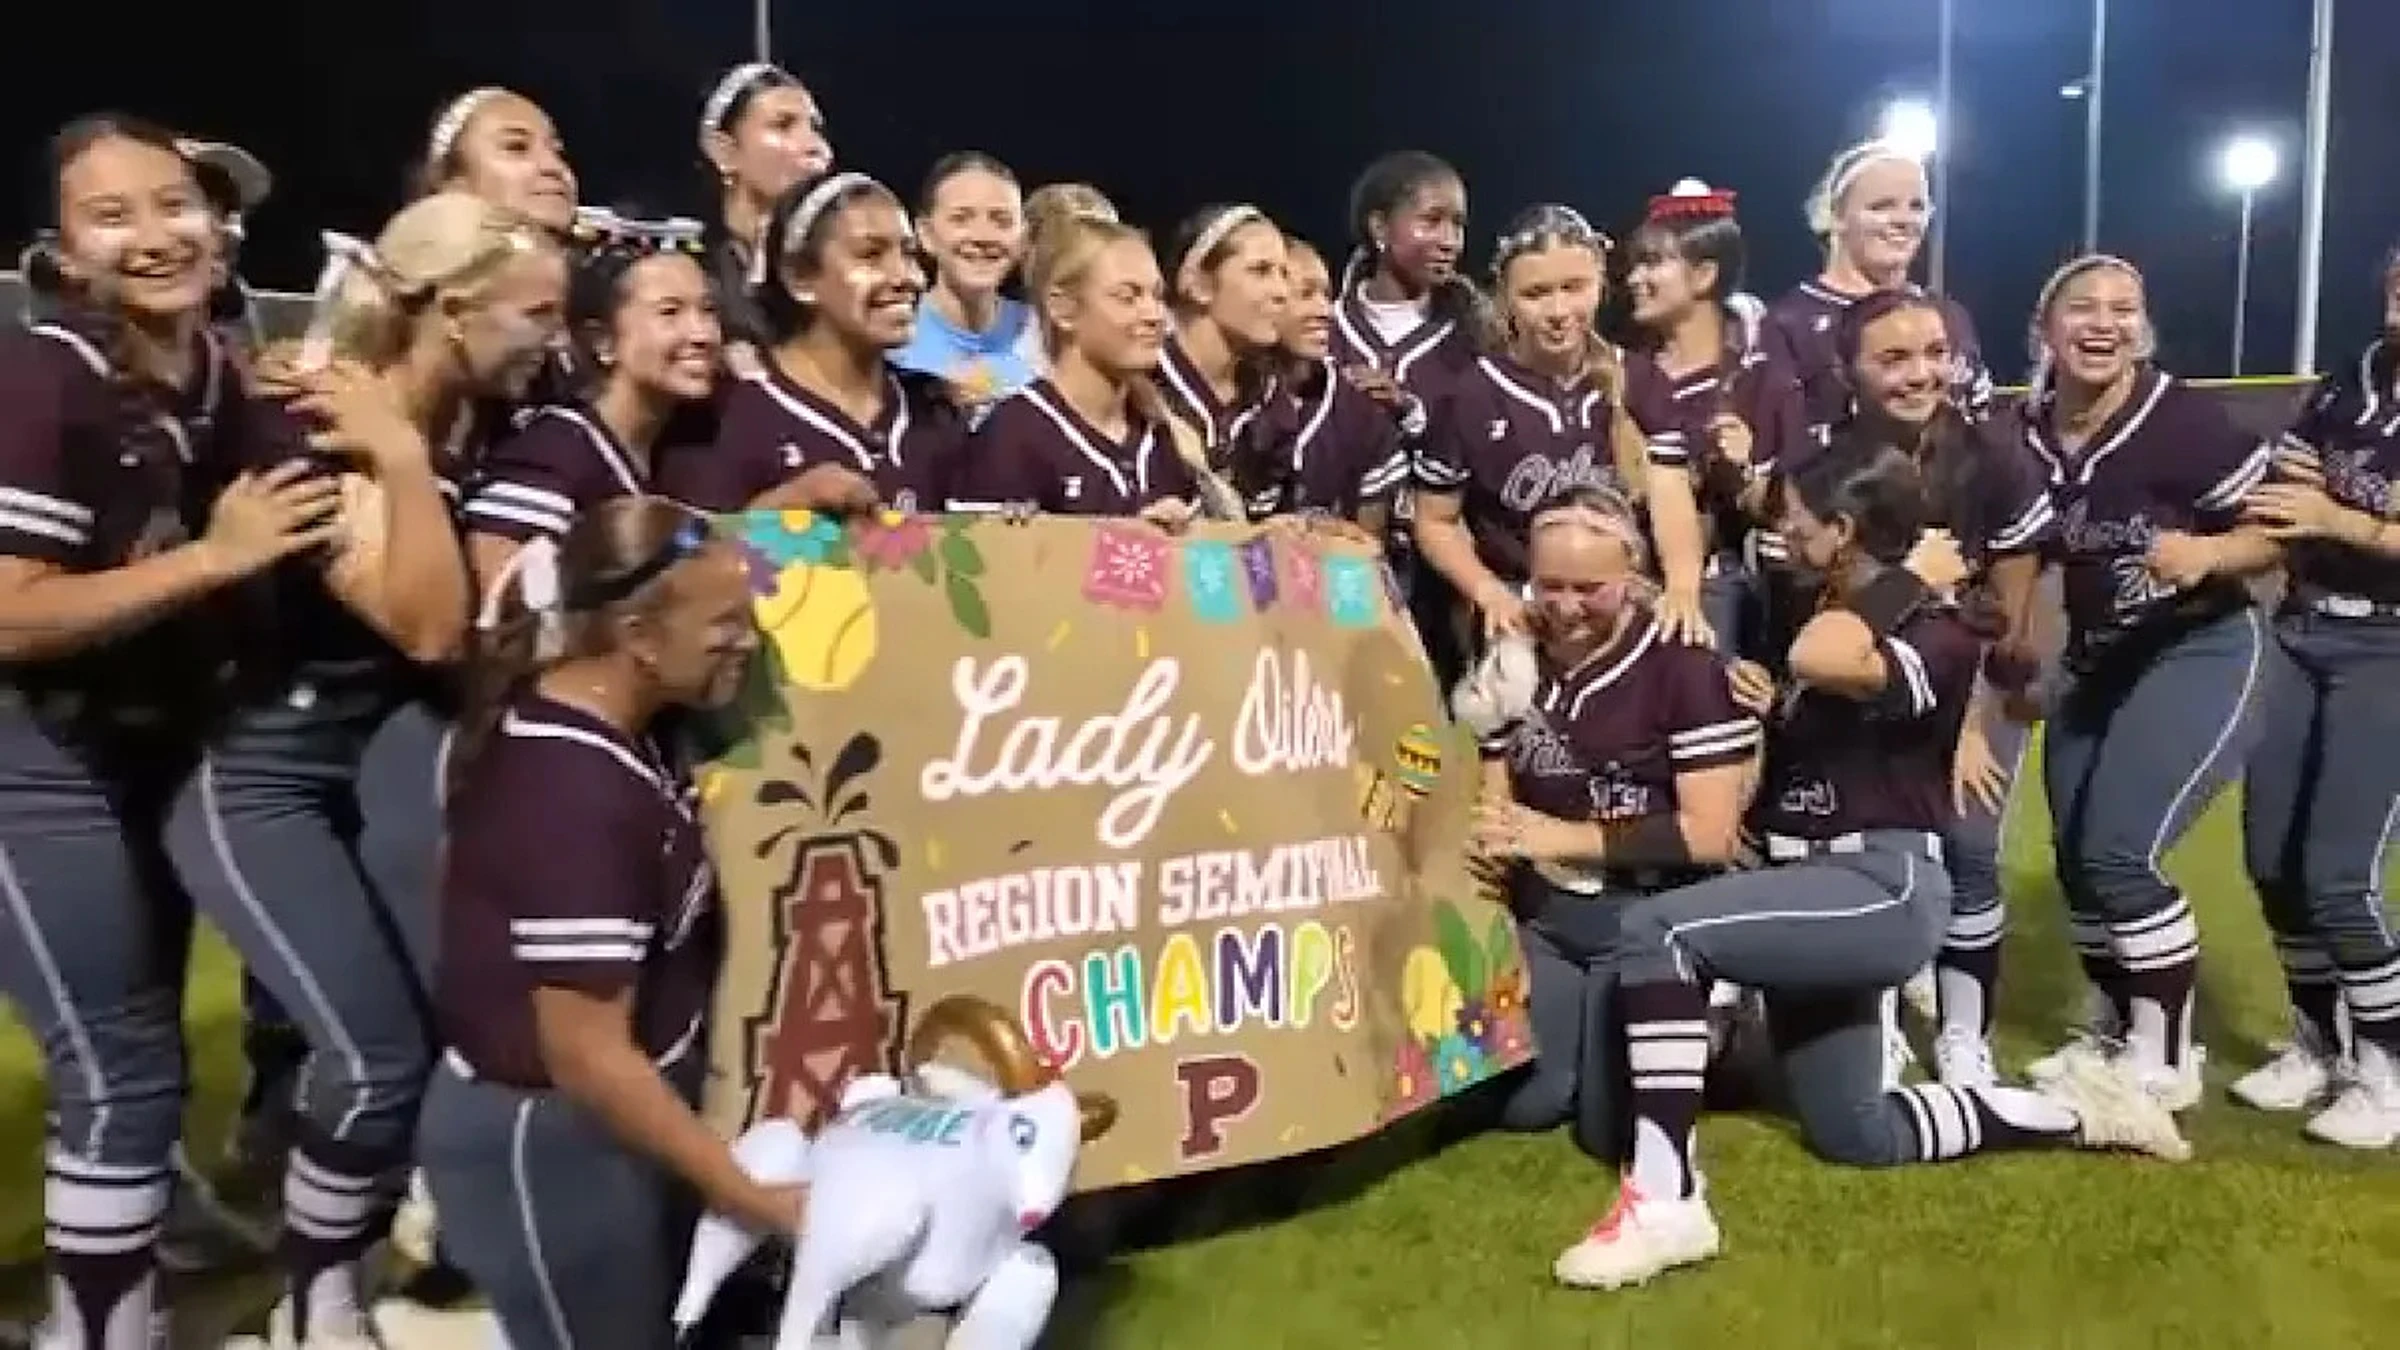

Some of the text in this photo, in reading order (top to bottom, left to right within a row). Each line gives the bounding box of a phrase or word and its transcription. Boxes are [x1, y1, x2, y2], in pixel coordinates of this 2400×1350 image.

[921, 655, 1216, 848] Lady
[1234, 646, 1355, 773] Oilers
[922, 835, 1384, 967] REGION SEMIFINAL
[1020, 921, 1358, 1073] CHAMPS
[1174, 1053, 1263, 1160] P
